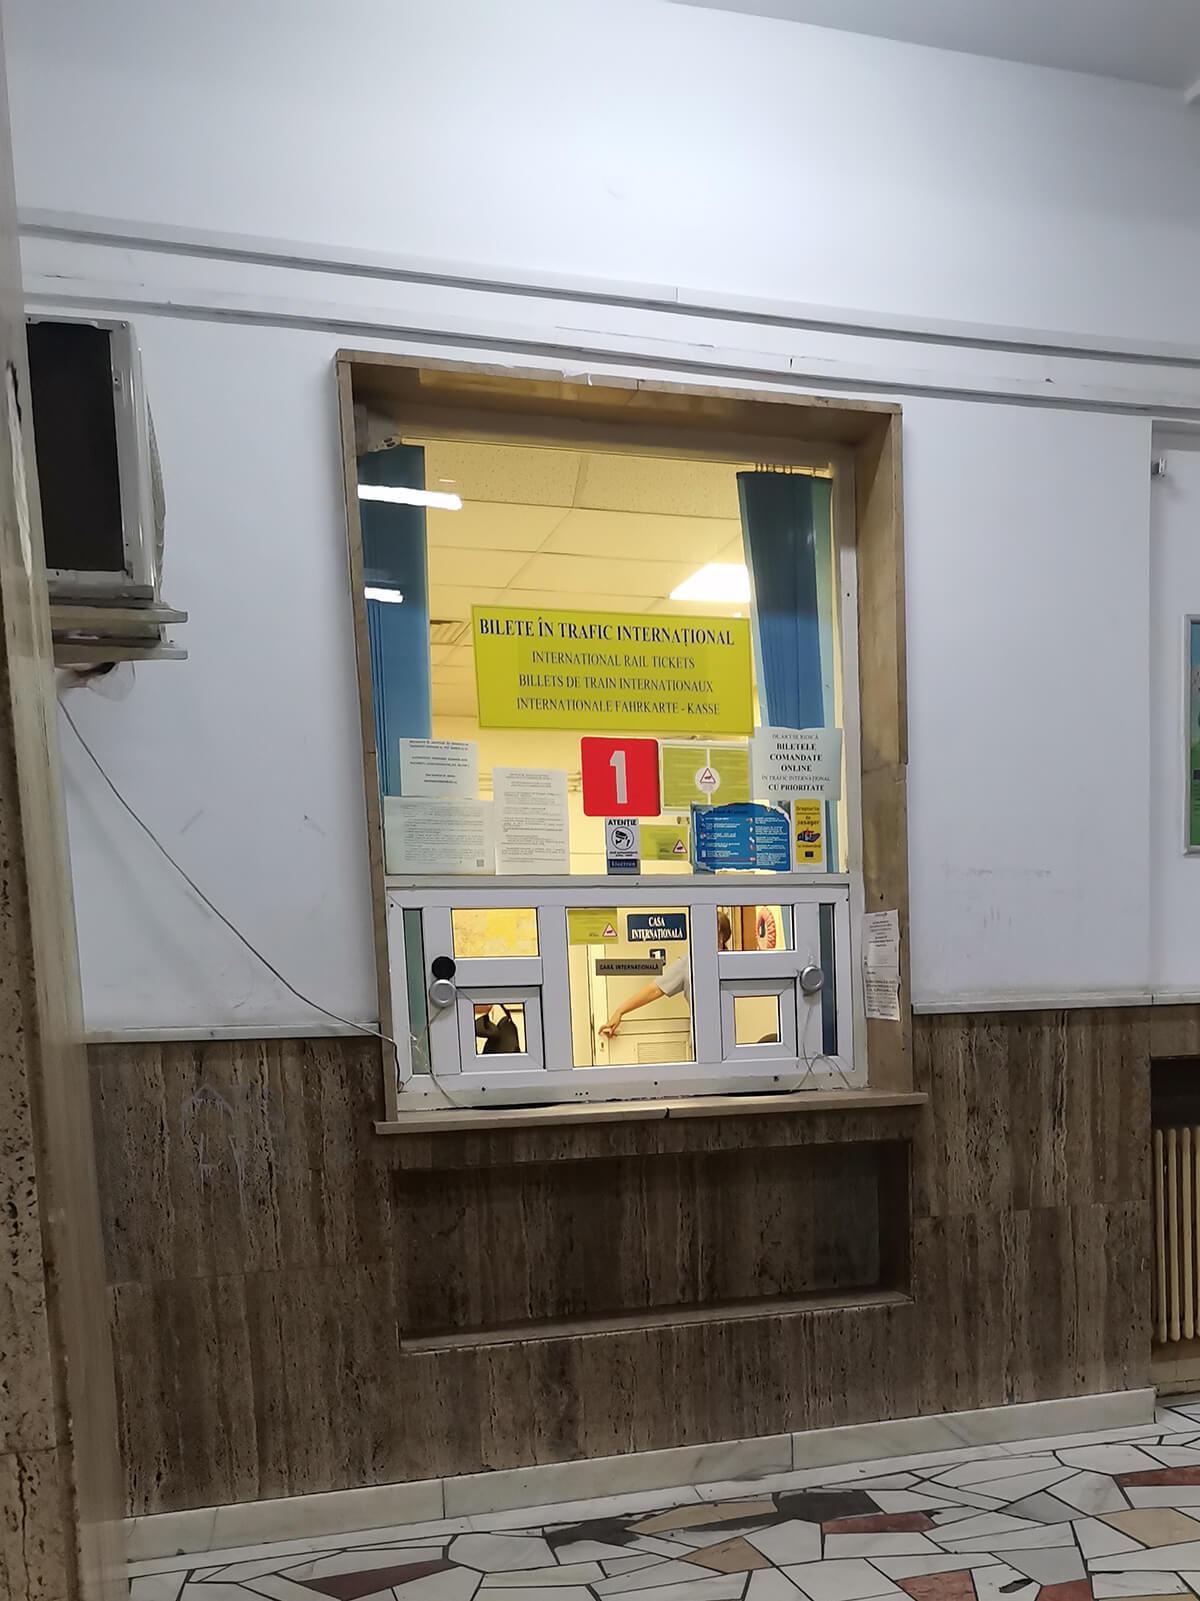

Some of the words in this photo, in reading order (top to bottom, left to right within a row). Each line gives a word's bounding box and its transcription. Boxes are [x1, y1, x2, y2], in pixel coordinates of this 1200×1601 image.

[480, 618, 534, 637] BILETE
[538, 616, 554, 637] ÎN
[558, 622, 613, 641] TRAFIC
[617, 625, 735, 647] INTERNAȚIONAL
[532, 650, 621, 668] INTERNATIONAL
[624, 654, 648, 669] RAIL
[652, 656, 695, 670] TICKETS
[519, 673, 564, 689] BILLETS
[566, 675, 581, 689] DE
[584, 676, 617, 690] TRAIN
[619, 677, 713, 693] INTERNATIONAUX
[516, 697, 613, 713] INTERNATIONALE
[615, 700, 679, 714] FAHRKARTE
[687, 702, 720, 715] KASSE
[776, 743, 816, 751] BILETELE
[769, 753, 823, 761] COMANDATE
[781, 764, 812, 772] ONLINE
[609, 750, 628, 804] 1
[780, 784, 824, 792] PRIORITATE
[648, 916, 665, 927] CASA
